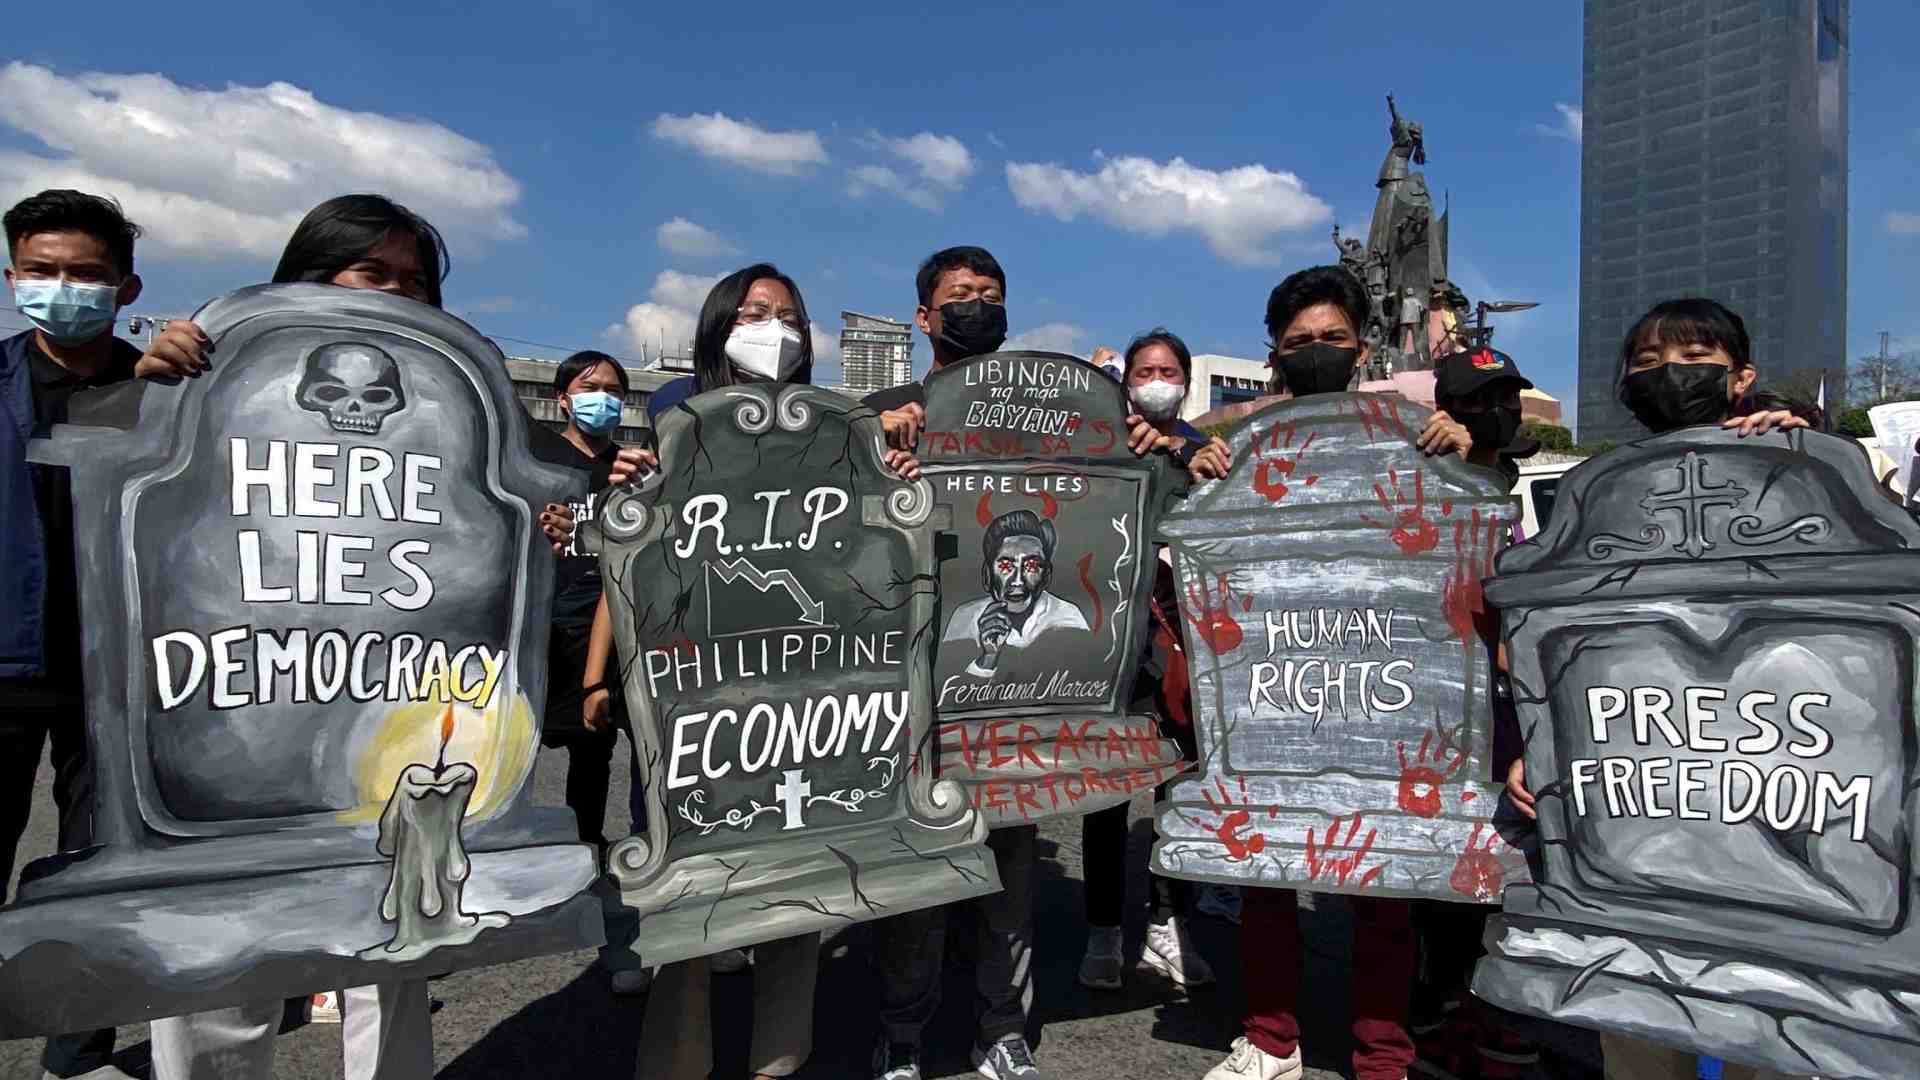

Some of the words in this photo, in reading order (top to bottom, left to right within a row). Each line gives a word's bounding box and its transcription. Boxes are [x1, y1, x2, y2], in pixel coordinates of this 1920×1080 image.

[964, 359, 1091, 392] LIBINGAN
[989, 386, 1014, 404] ng
[1022, 386, 1061, 405] mga
[230, 437, 442, 525] HERE
[946, 475, 1013, 493] HERE
[1024, 476, 1083, 493] LIES
[673, 486, 849, 559] R.I.P.
[237, 529, 436, 612] LIES
[151, 624, 510, 711] DEMOCRACY
[645, 631, 904, 698] PHILIPPINE
[1264, 606, 1394, 659] HUMAN
[937, 671, 1045, 707] Ferdinand
[1037, 670, 1110, 700] Marcos
[1249, 658, 1415, 734] RIGHTS
[1585, 686, 1834, 758] PRESS
[666, 690, 909, 789] ECONOMY
[939, 719, 1046, 776] EVER
[1051, 719, 1162, 770] AGAIN
[1570, 756, 1873, 842] FREEDOM
